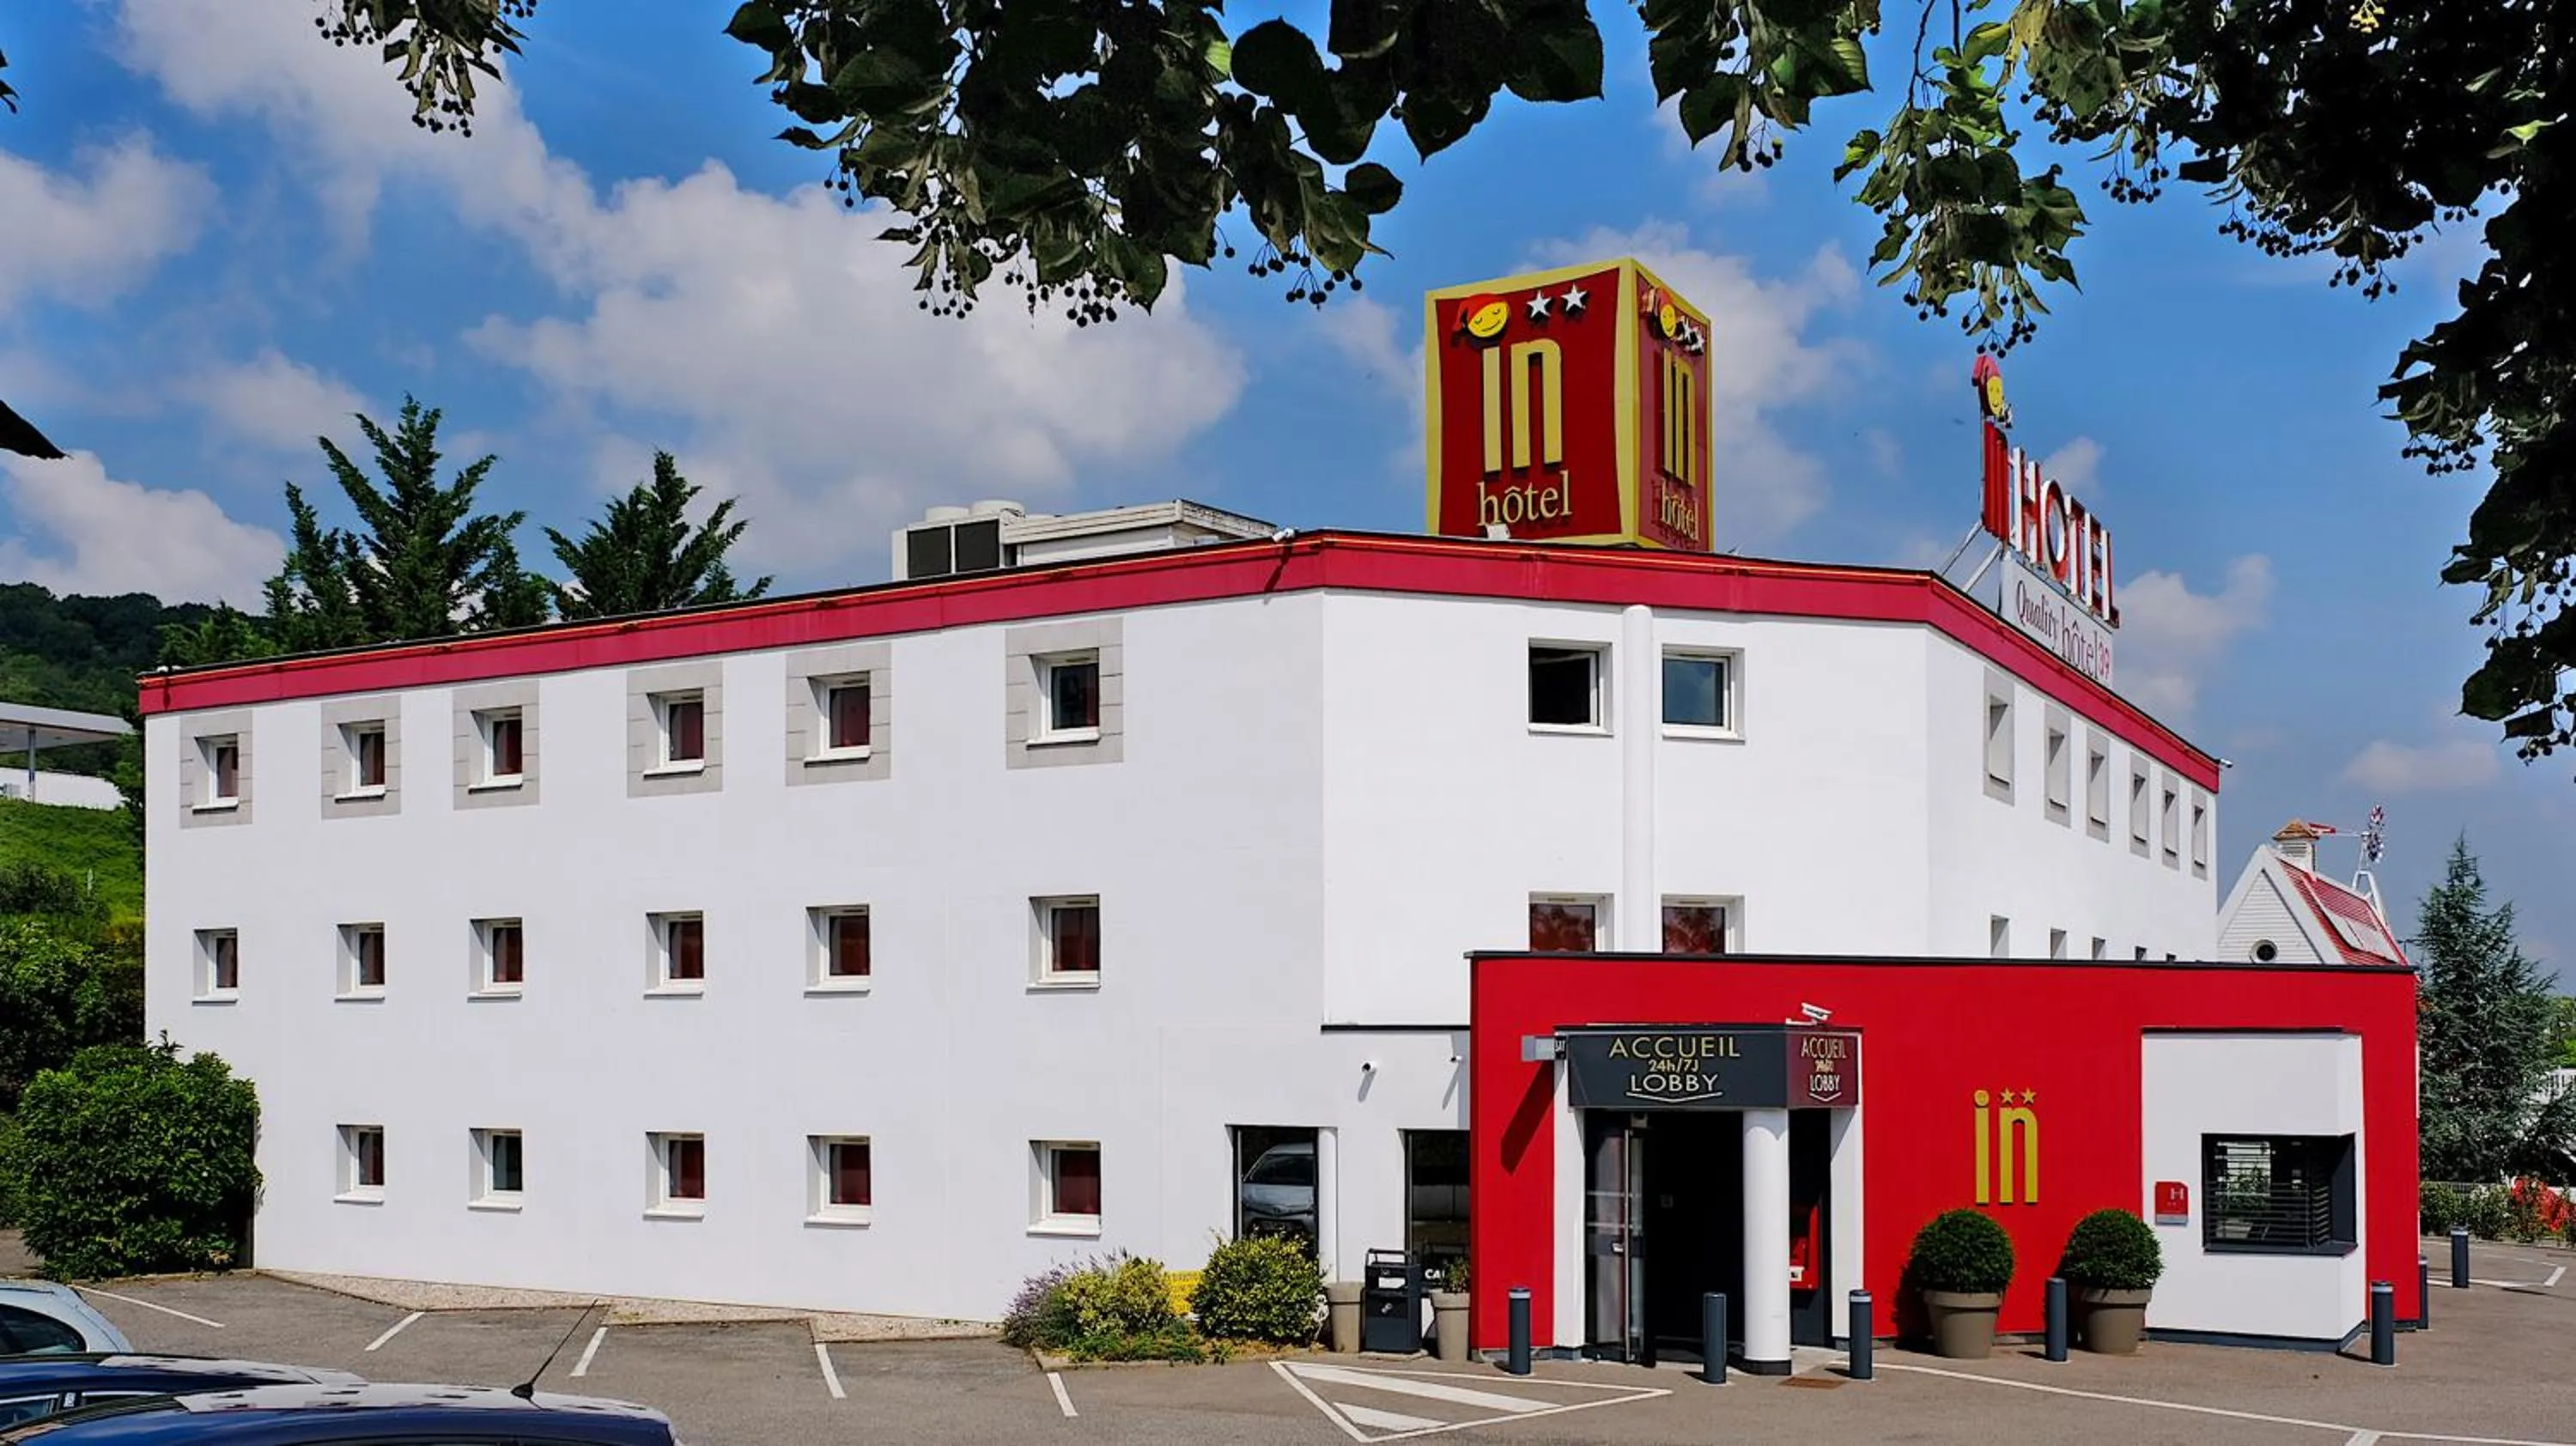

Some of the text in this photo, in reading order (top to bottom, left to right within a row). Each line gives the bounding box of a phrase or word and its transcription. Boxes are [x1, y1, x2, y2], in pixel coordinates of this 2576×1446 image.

[1482, 338, 1564, 473] in
[1475, 470, 1573, 527] hôtel
[1661, 477, 1700, 543] hôtel
[2012, 446, 2120, 629] HOTEL
[2016, 580, 2058, 651] Quality
[2061, 605, 2099, 680] hôtel
[1608, 1036, 1741, 1059] ACCUEIL
[1801, 1036, 1847, 1059] ACCUEIL
[1630, 1073, 1718, 1092] LOBBY
[1808, 1074, 1841, 1091] LOBBY
[1974, 1088, 2038, 1205] in
[2170, 1187, 2185, 1200] H
